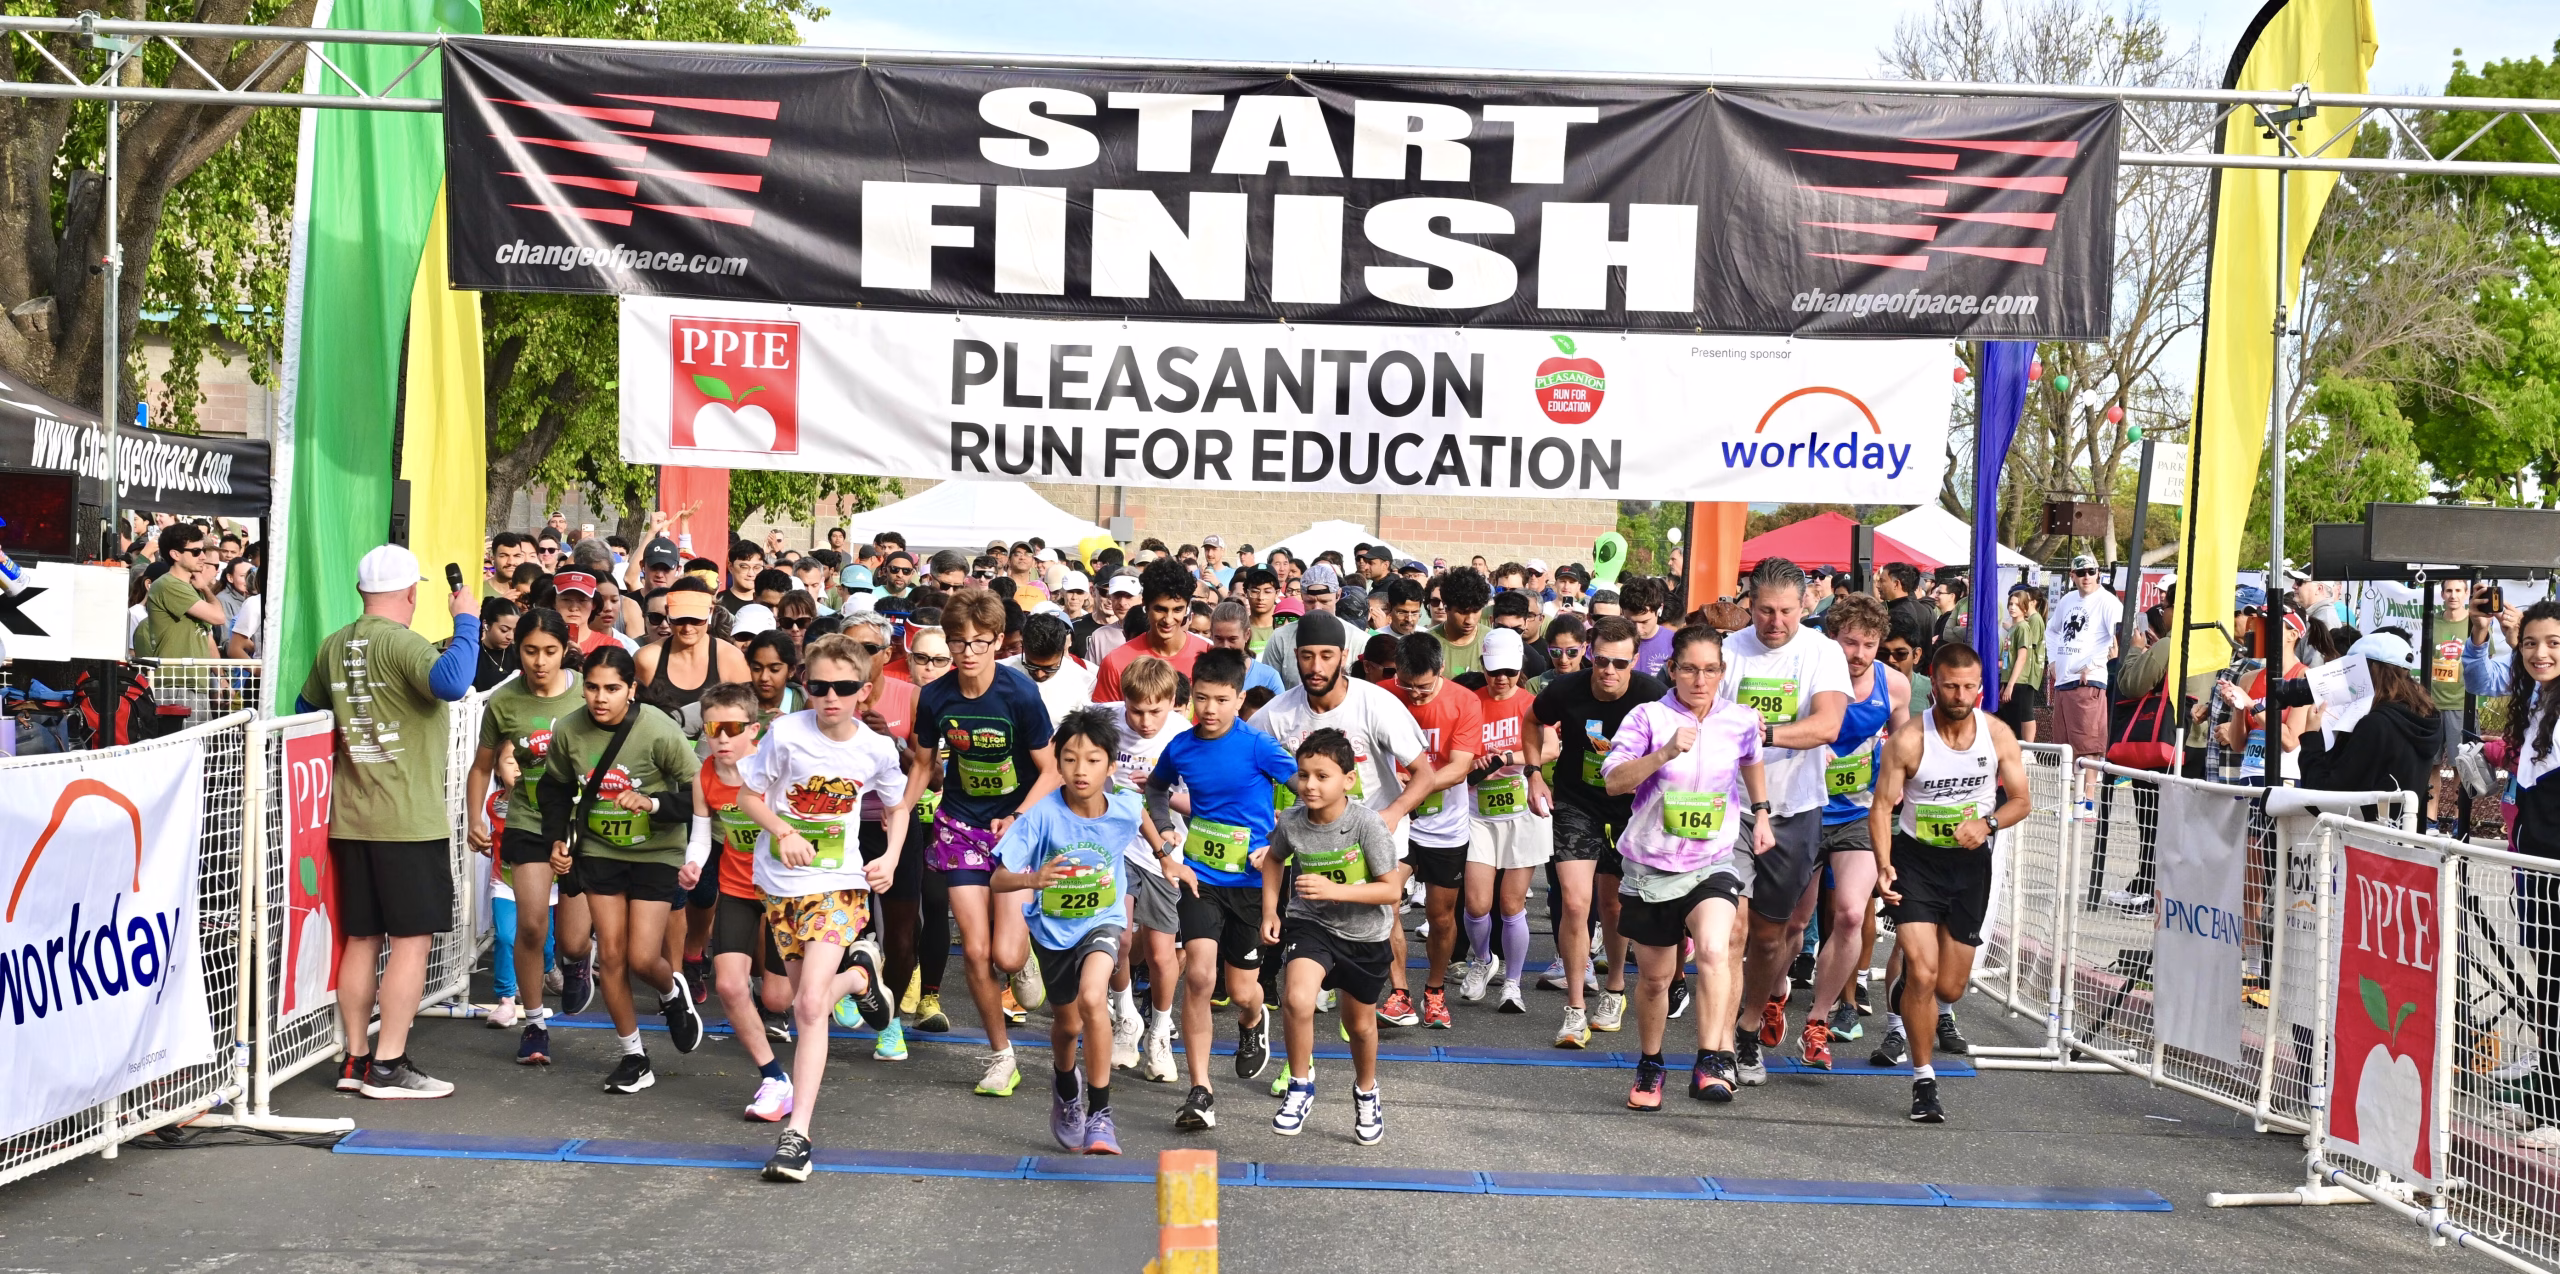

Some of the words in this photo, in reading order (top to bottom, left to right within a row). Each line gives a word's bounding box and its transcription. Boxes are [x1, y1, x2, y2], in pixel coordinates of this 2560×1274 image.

[977, 86, 1598, 184] START
[861, 180, 1698, 312] FINISH
[495, 239, 749, 278] changeofpace.com
[1791, 287, 2039, 319] changeofpace.com
[680, 327, 790, 370] PPIE
[1691, 347, 1747, 361] Presenting
[1750, 349, 1792, 360] sponsor
[951, 338, 1484, 419] PLEASANTON
[1537, 373, 1604, 390] PLEASANTON
[1553, 388, 1570, 400] RUN
[1571, 389, 1587, 401] FOR
[1548, 401, 1591, 413] EDUCATION
[31, 416, 234, 503] www.changeofpace.com
[951, 422, 1083, 477] RUN
[1105, 427, 1233, 482] FOR
[1252, 429, 1622, 491] EDUCATION
[1721, 431, 1912, 480] workday
[2157, 460, 2185, 472] PARK
[2168, 477, 2185, 487] FIR
[2163, 488, 2185, 499] LAN
[2433, 667, 2454, 678] 1778
[1750, 695, 1783, 713] 298
[1481, 716, 1519, 743] BURN
[989, 736, 1006, 744] FOR
[969, 775, 1003, 789] 349
[1835, 771, 1856, 786] 36
[1923, 777, 1959, 789] FLEET
[1960, 774, 1989, 787] FEET
[1487, 792, 1515, 808] 288
[601, 819, 632, 836] 277
[1679, 811, 1713, 829] 164
[1203, 839, 1226, 860] 93
[1060, 891, 1100, 910] 228
[2356, 874, 2433, 973] PPIE
[0, 892, 180, 1026] workday
